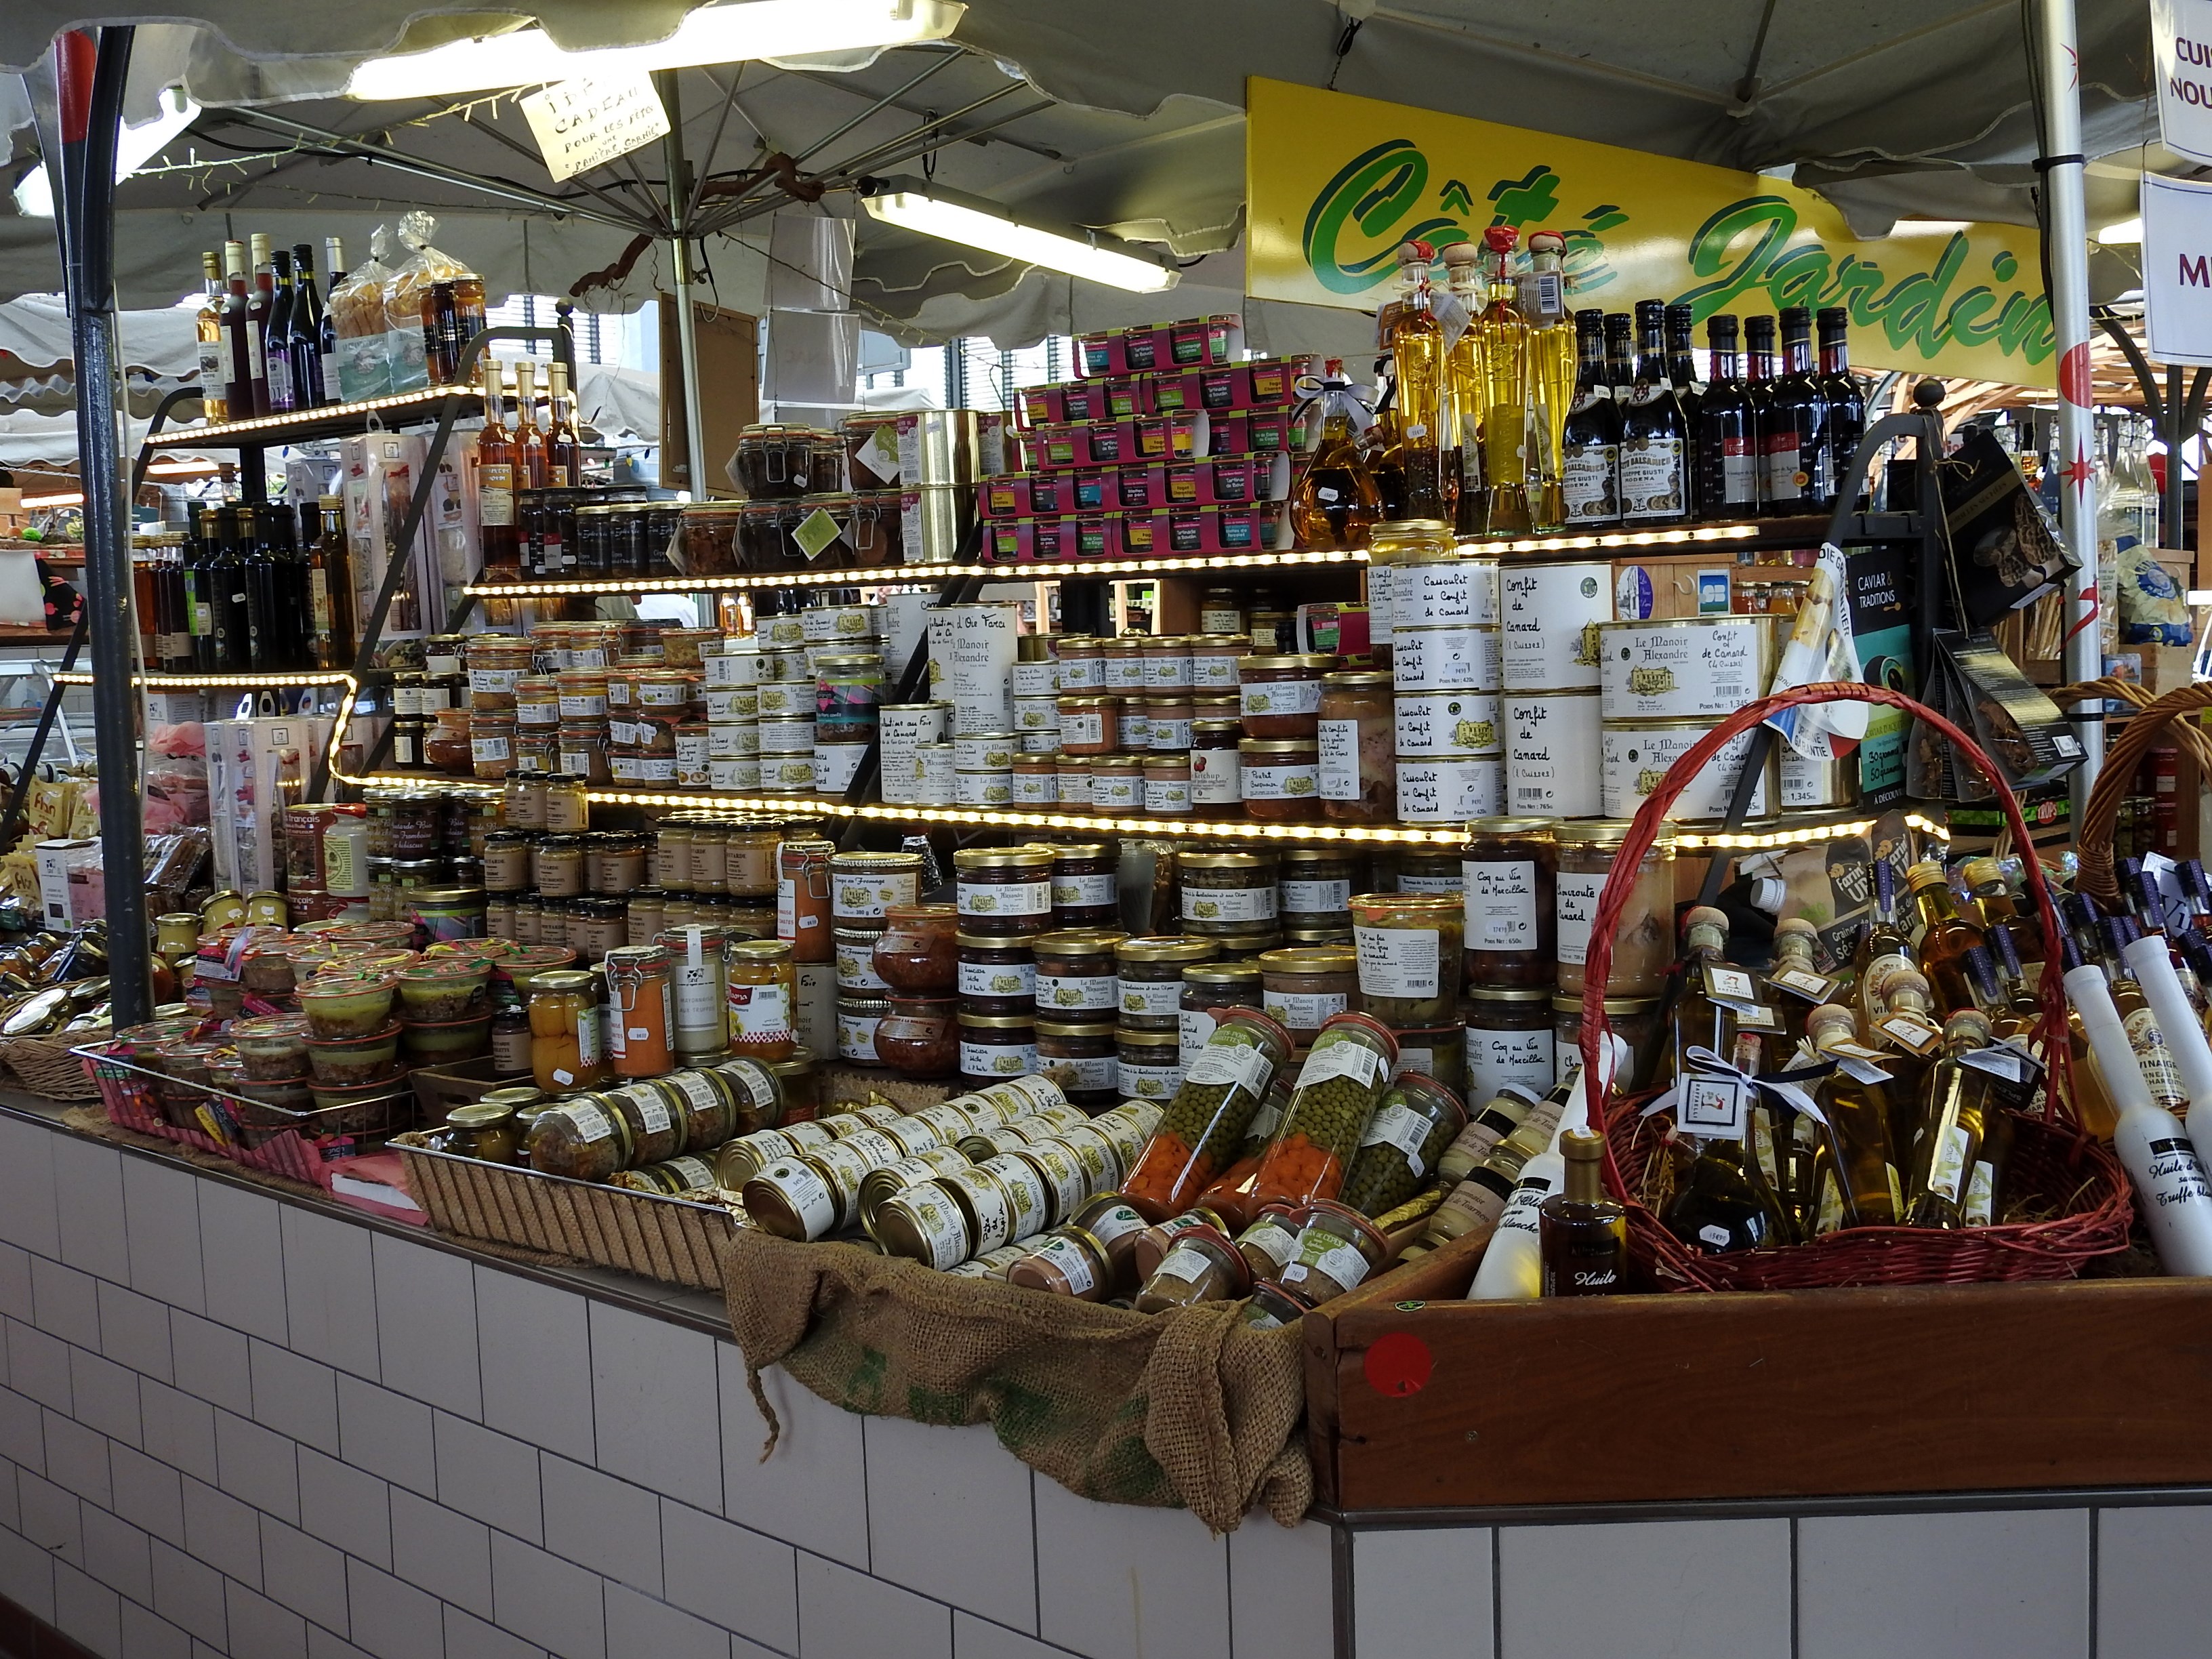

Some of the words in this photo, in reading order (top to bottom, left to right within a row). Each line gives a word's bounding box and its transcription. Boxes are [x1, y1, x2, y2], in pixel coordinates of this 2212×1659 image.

[2175, 37, 2212, 68] CUI
[2179, 253, 2212, 287] M
[1670, 194, 2055, 365] Jardin
[1631, 457, 1671, 466] BALSAMICO
[1424, 574, 1468, 586] Cassoulet
[1858, 572, 1885, 591] CAVIAR
[1507, 577, 1537, 598] Confit
[1441, 589, 1467, 603] Confit
[1859, 590, 1896, 609] TRADITIONS
[1425, 607, 1433, 617] de
[1439, 605, 1469, 616] Canard
[1512, 598, 1523, 611] de
[1507, 617, 1540, 632] Canard
[1635, 637, 1646, 648] Le
[1650, 636, 1688, 649] Manoir
[1642, 649, 1688, 663] Alexandre
[1702, 649, 1711, 658] de
[1715, 646, 1748, 658] Canard
[1402, 656, 1423, 670] Confit
[1513, 705, 1547, 726] Confit
[1408, 722, 1430, 735] Confit
[1519, 726, 1532, 739] de
[1798, 723, 1822, 744] ORIGINE
[1408, 737, 1432, 746] Canard
[1643, 739, 1658, 750] Le
[1795, 737, 1828, 758] GARANTIE
[1513, 746, 1550, 760] Canard
[1194, 773, 1220, 781] Ketchup
[1413, 787, 1437, 801] Confit
[1412, 802, 1438, 812] Canard
[289, 814, 320, 823] français
[416, 821, 432, 830] Bio
[855, 877, 885, 885] Fromage
[1477, 872, 1491, 884] Coq
[1508, 867, 1521, 881] Vin
[1836, 861, 1864, 890] Farin'
[1481, 886, 1488, 895] de
[1565, 897, 1575, 908] de
[1292, 996, 1313, 1004] Manoir
[1492, 1041, 1507, 1054] Coq
[1513, 1044, 1522, 1052] au
[1526, 1037, 1538, 1050] Vin
[1496, 1055, 1505, 1064] de
[2149, 1160, 2184, 1179] Huile
[2156, 1187, 2194, 1206] Truffe
[1574, 1269, 1616, 1286] Huile
